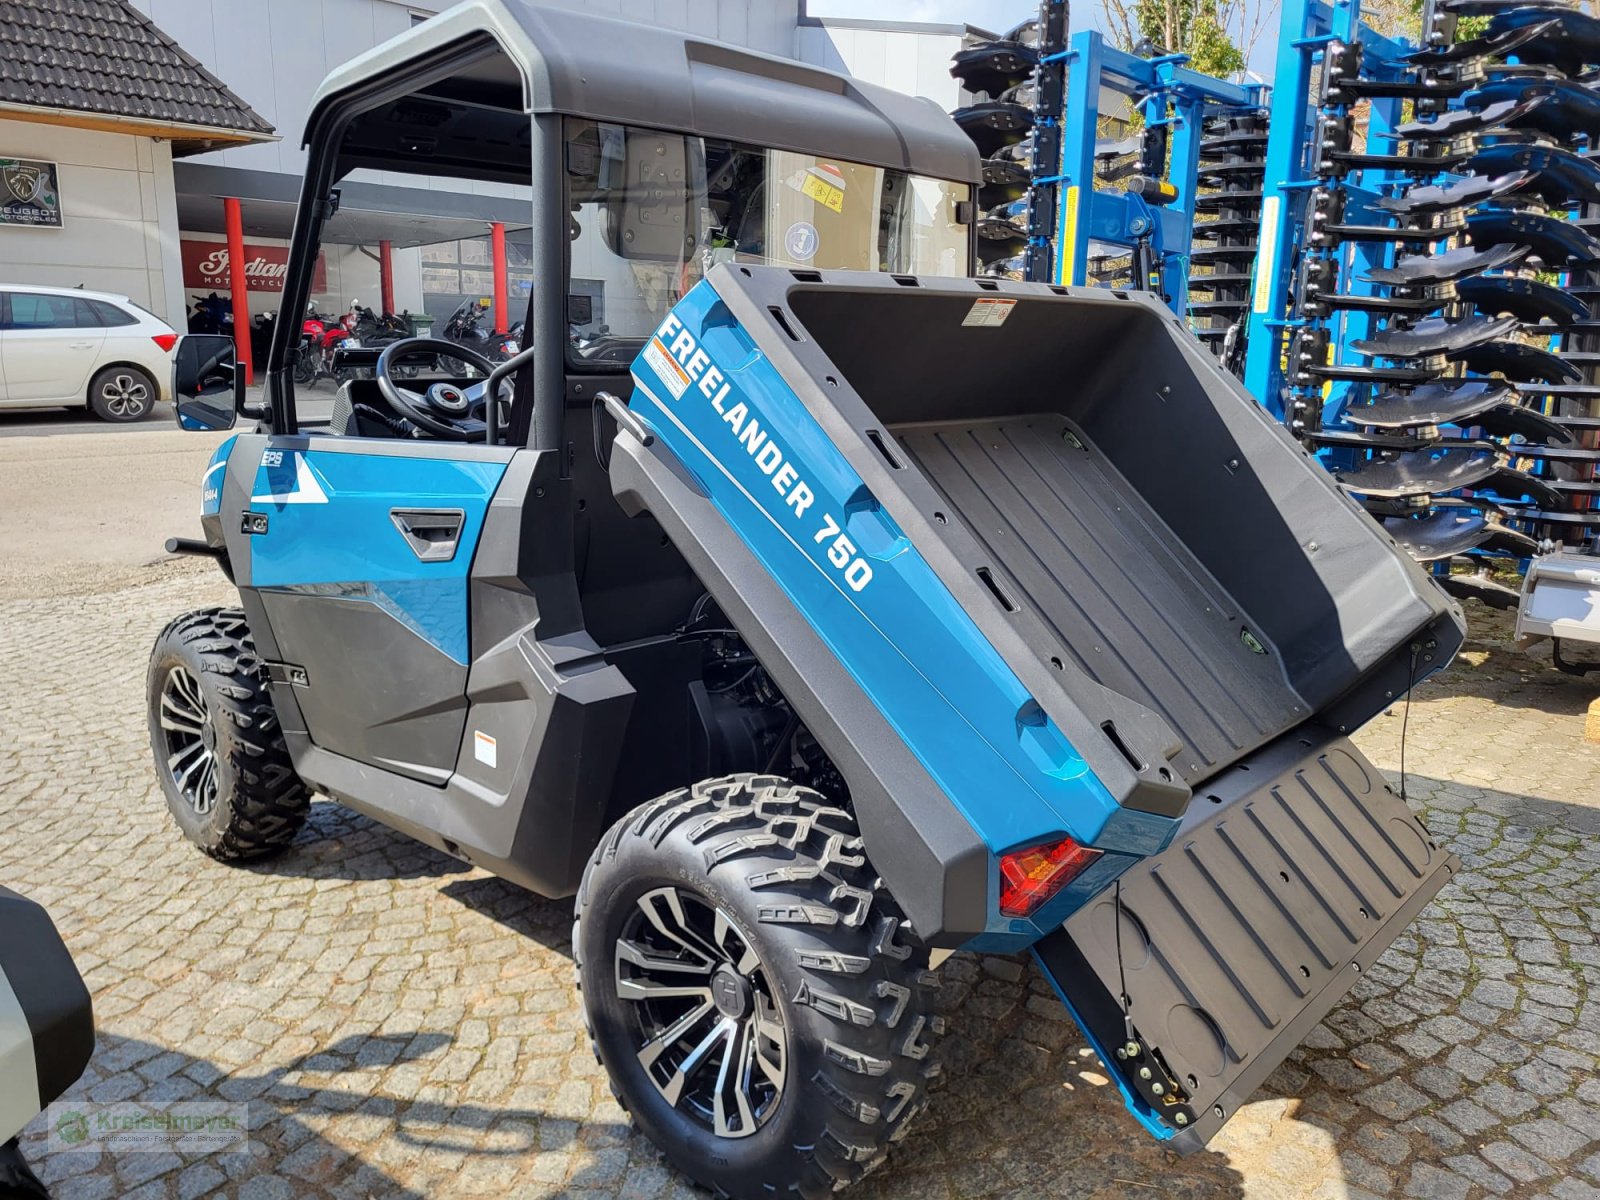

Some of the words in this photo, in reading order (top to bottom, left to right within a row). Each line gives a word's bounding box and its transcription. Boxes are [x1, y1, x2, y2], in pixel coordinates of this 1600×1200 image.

[199, 249, 288, 278] Idian
[204, 276, 283, 287] MOTCYCL
[262, 450, 284, 465] EPS
[657, 312, 815, 519] FREELANDER
[813, 513, 873, 592] 750
